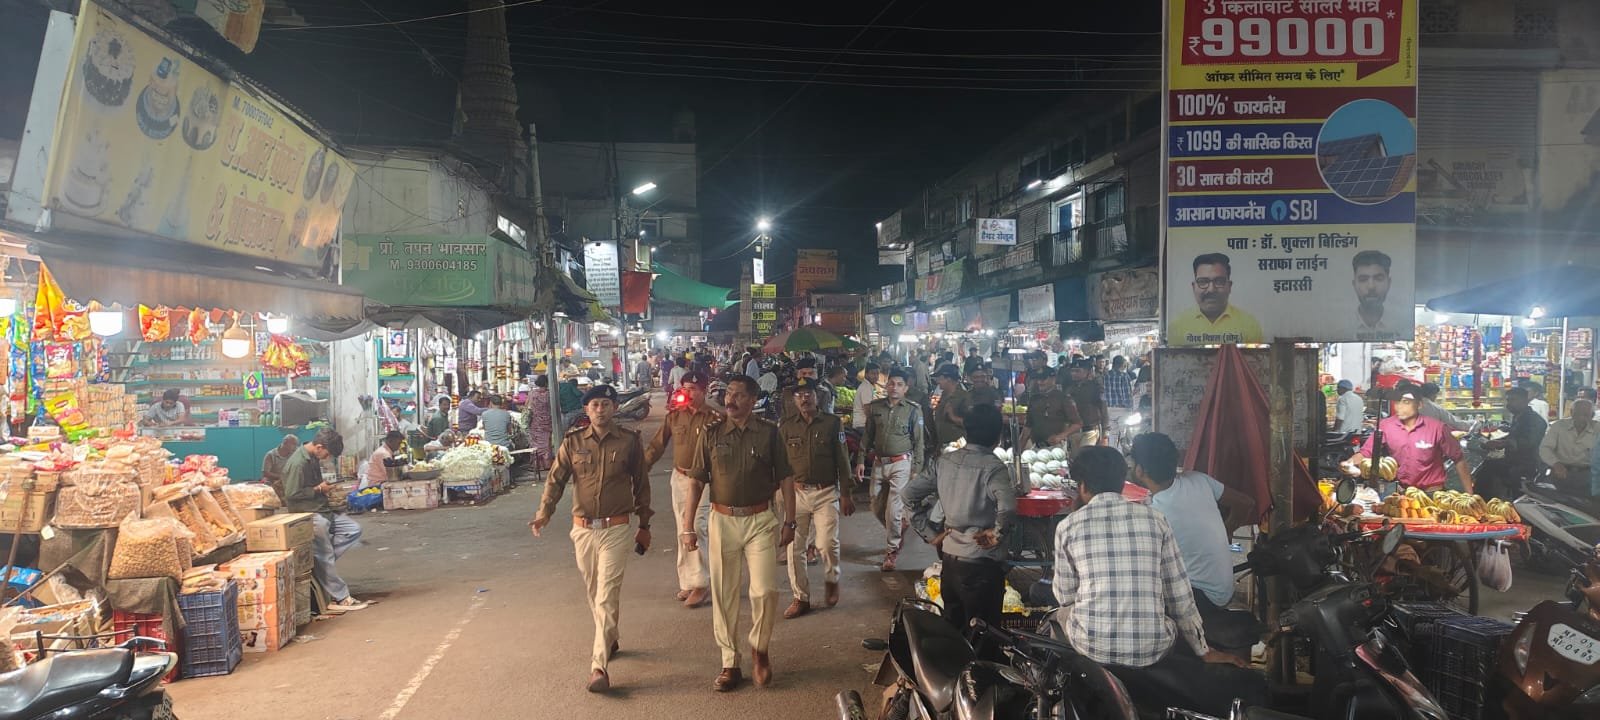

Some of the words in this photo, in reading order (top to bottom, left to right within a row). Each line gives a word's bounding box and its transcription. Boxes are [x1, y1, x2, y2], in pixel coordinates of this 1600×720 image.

[1203, 0, 1216, 15] 3
[1205, 68, 1235, 82] ऑफर
[1239, 68, 1271, 82] सीमित
[1275, 72, 1301, 81] समय
[1306, 68, 1316, 80] के
[1226, 133, 1242, 150] की
[1243, 132, 1281, 150] मासिक
[1282, 131, 1313, 150] किस्त
[1176, 165, 1196, 186] 30
[1200, 174, 1223, 186] साल
[1225, 167, 1242, 185] की
[1175, 207, 1215, 221] आसान
[1289, 200, 1318, 221] SBI
[379, 236, 399, 256] प्रो.
[404, 242, 432, 255] तपन
[1227, 237, 1248, 249] पता
[1260, 233, 1277, 249] डॉ.
[1281, 236, 1314, 253] शुक्ला
[1318, 232, 1358, 248] बिल्डिंग
[407, 259, 478, 271] 9300604185
[1258, 258, 1292, 271] सराफा
[1296, 253, 1328, 271] लाईन
[1273, 275, 1313, 292] इटारसी
